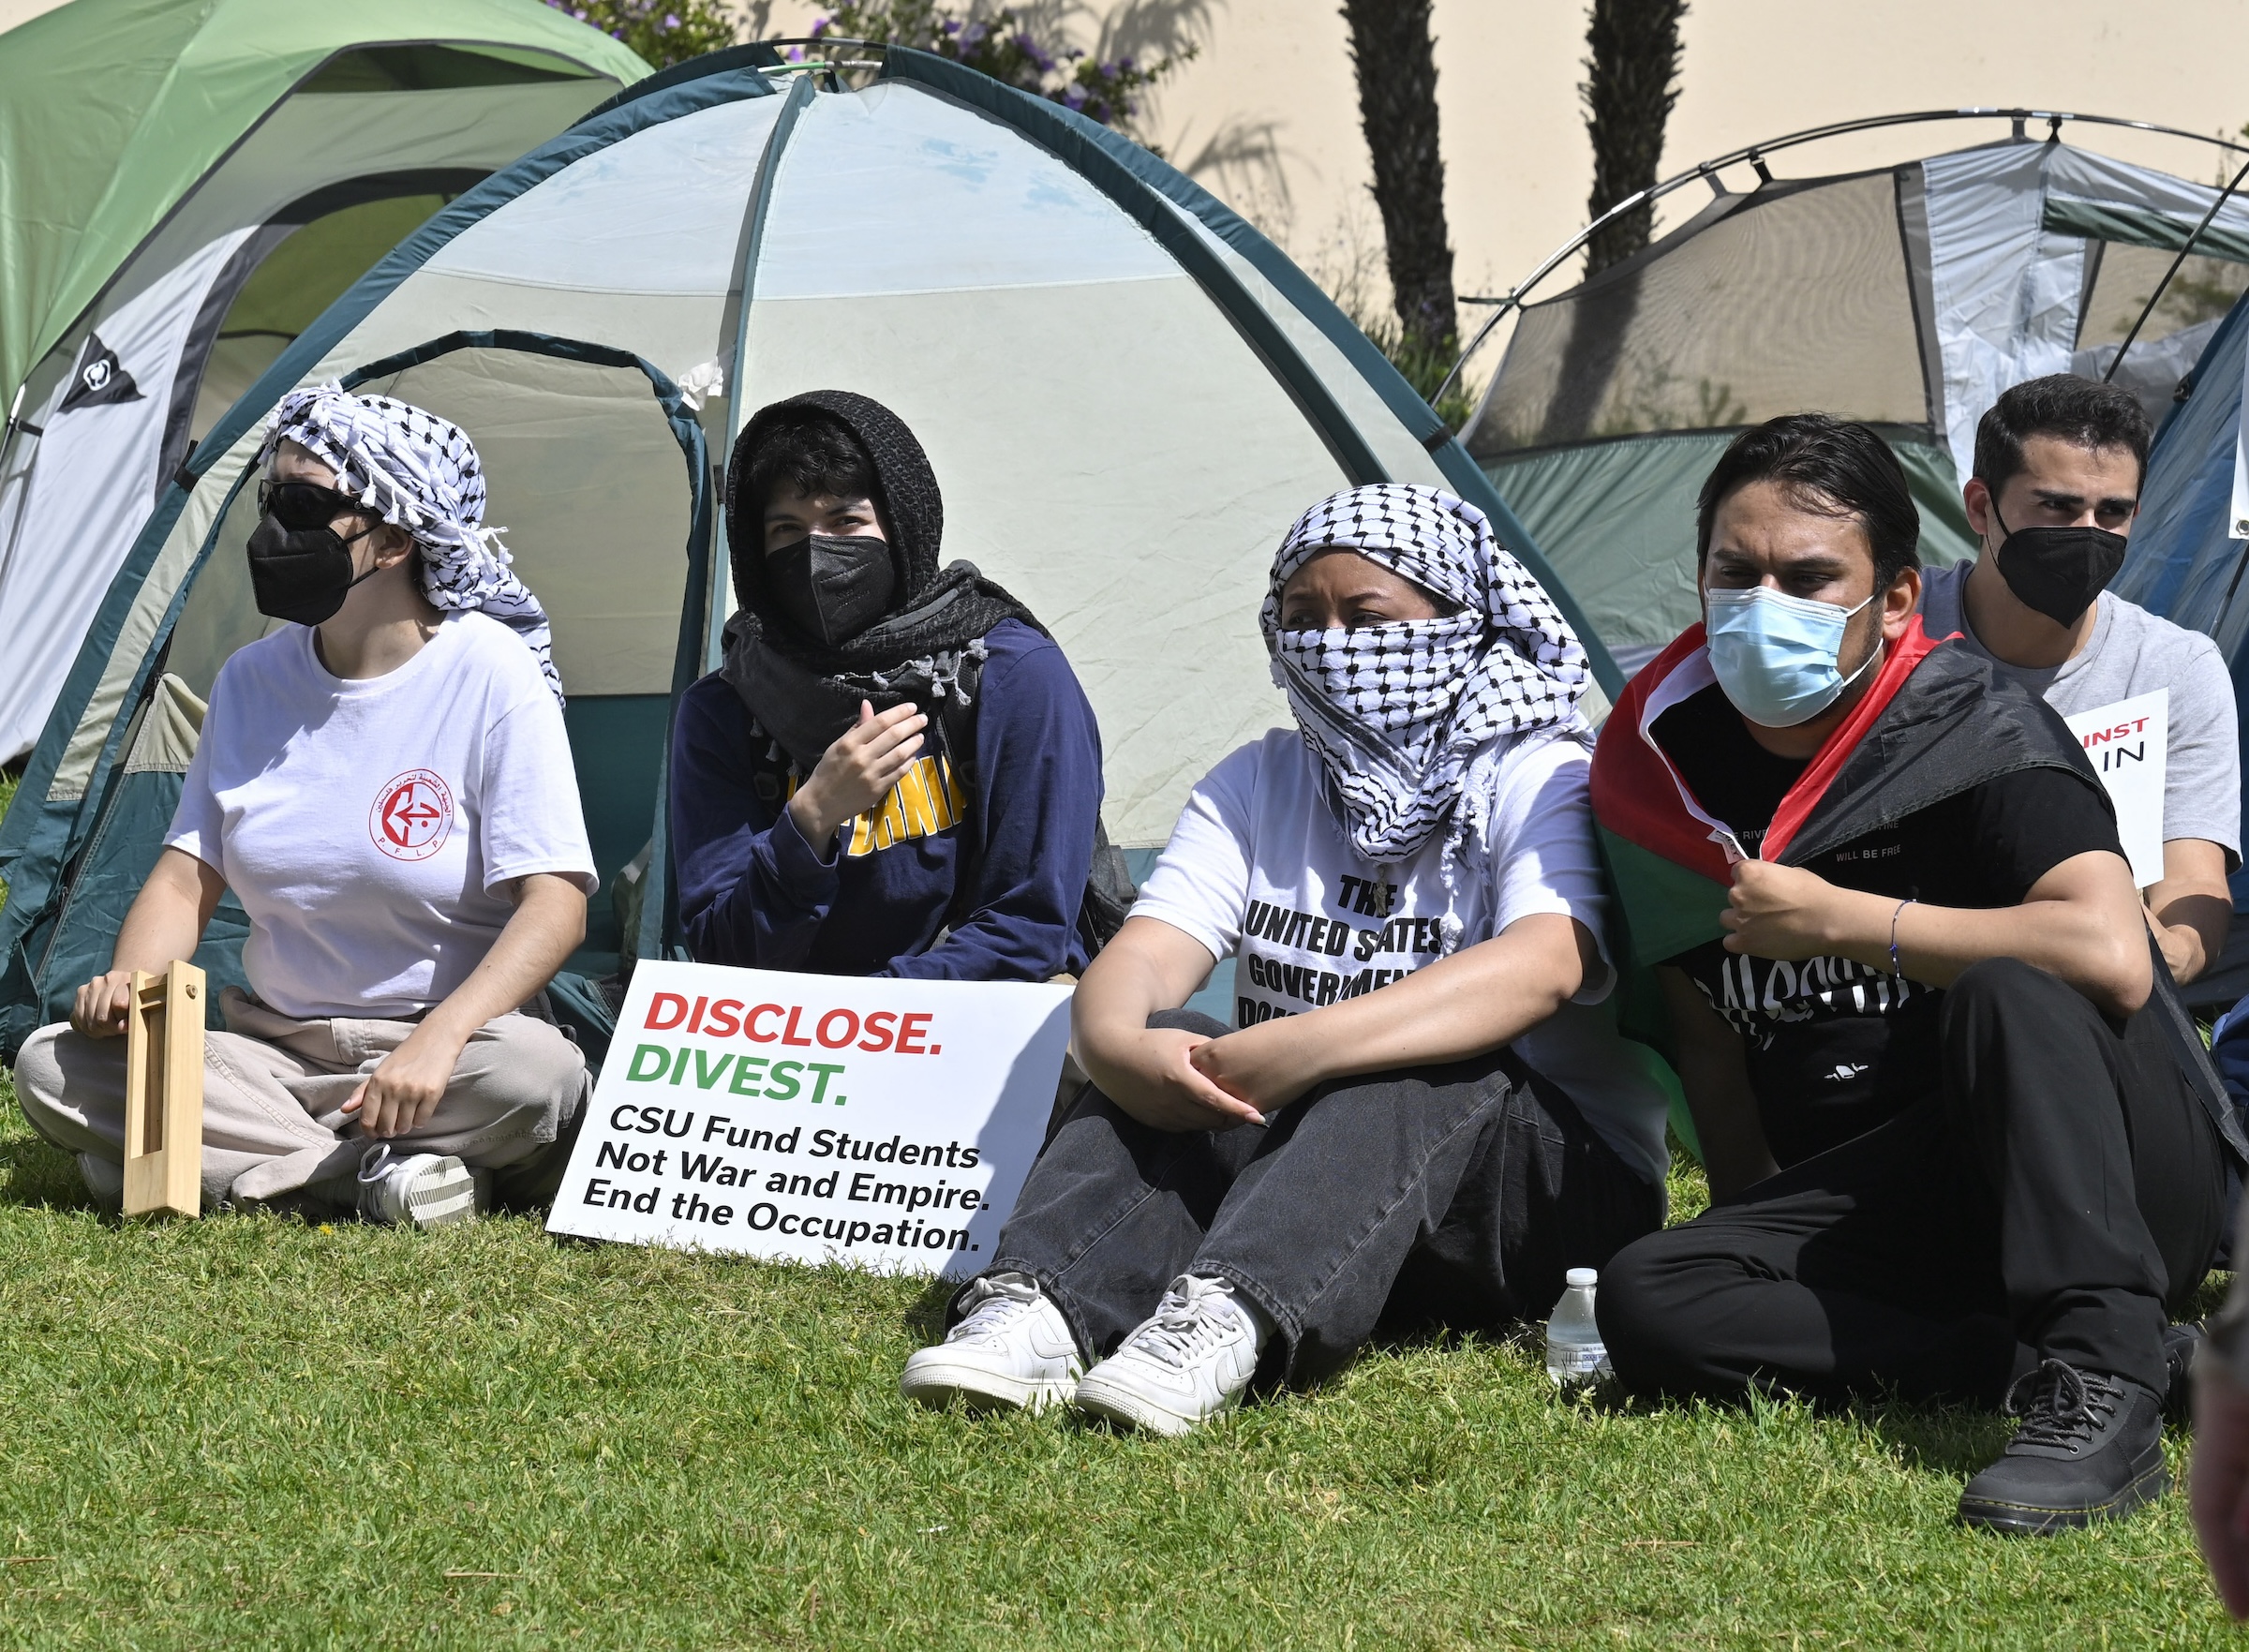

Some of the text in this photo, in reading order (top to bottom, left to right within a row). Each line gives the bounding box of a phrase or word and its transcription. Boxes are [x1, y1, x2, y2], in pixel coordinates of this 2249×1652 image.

[1836, 843, 1901, 862] WILL BE FREE
[1244, 899, 1350, 957] UNITED
[643, 991, 943, 1055] DISCLOSE.
[626, 1043, 848, 1107] DIVEST.
[610, 1104, 980, 1168] CSU Fund Students
[595, 1141, 990, 1213] Not War and Empire.
[583, 1178, 980, 1252] End the Occupation.
